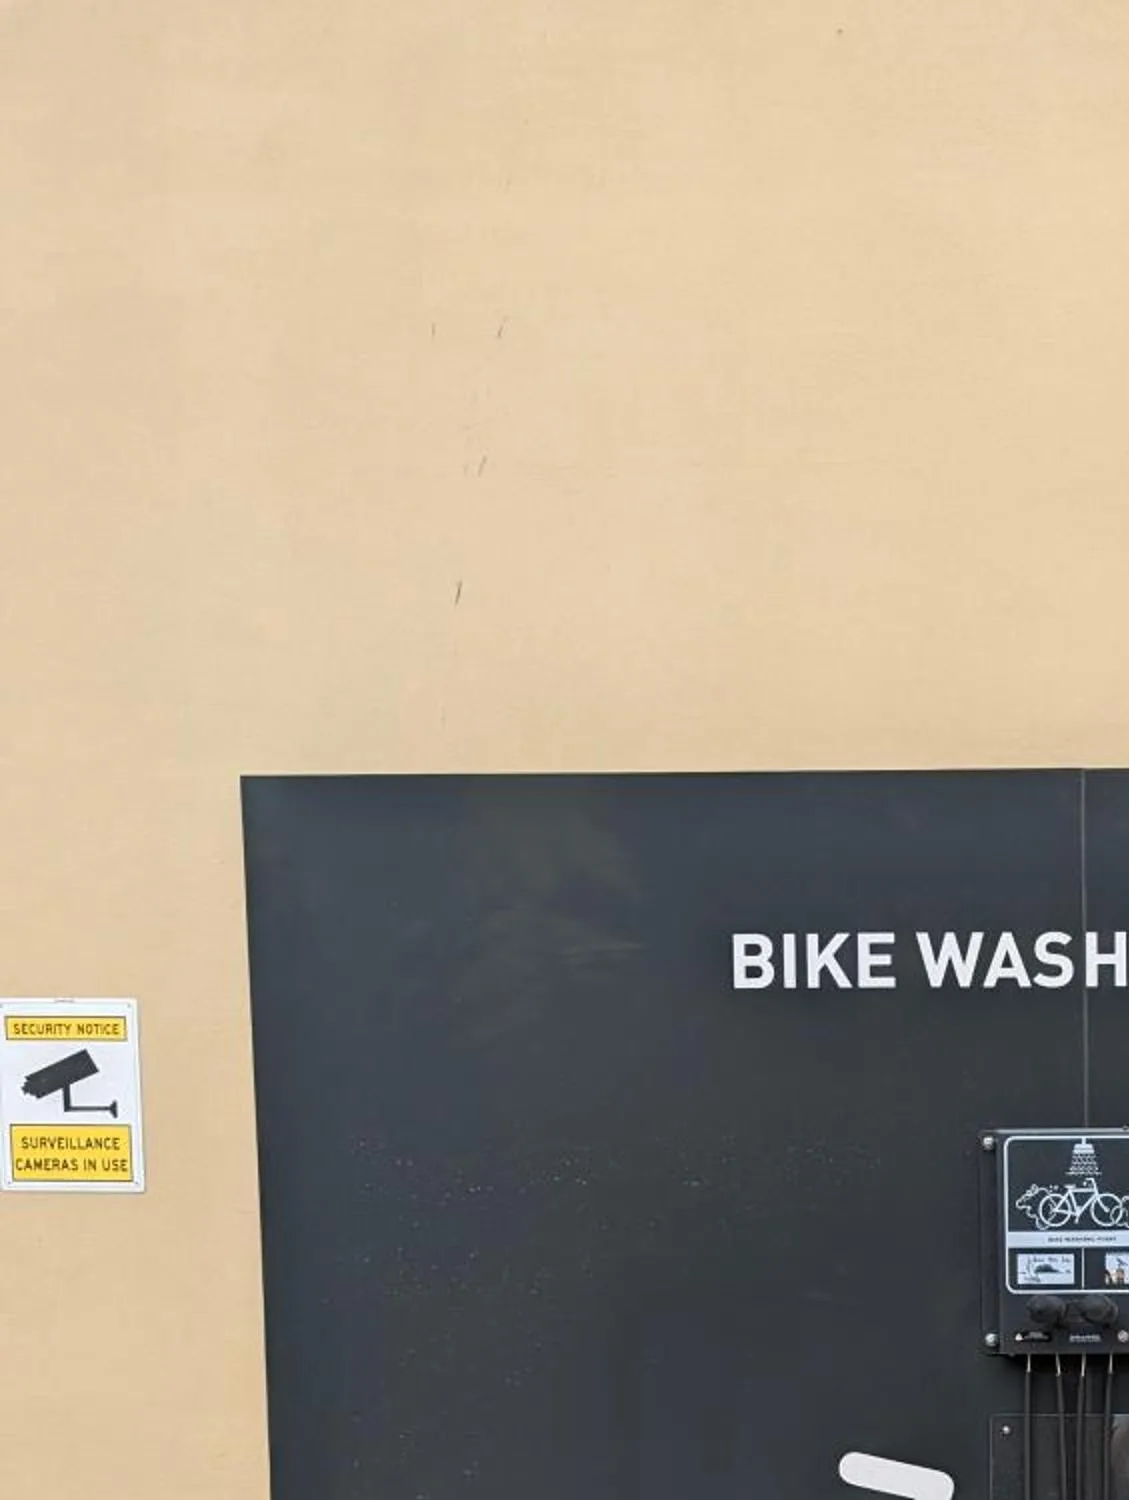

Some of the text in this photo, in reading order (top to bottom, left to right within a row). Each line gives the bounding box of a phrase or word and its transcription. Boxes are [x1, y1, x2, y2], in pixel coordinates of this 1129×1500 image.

[732, 932, 896, 989] BIKE
[915, 931, 1127, 988] WASH
[13, 1023, 120, 1036] SECURITY NOTICE
[21, 1136, 120, 1151] SURVEILLANCE
[15, 1158, 128, 1173] CAMERAS IN USE
